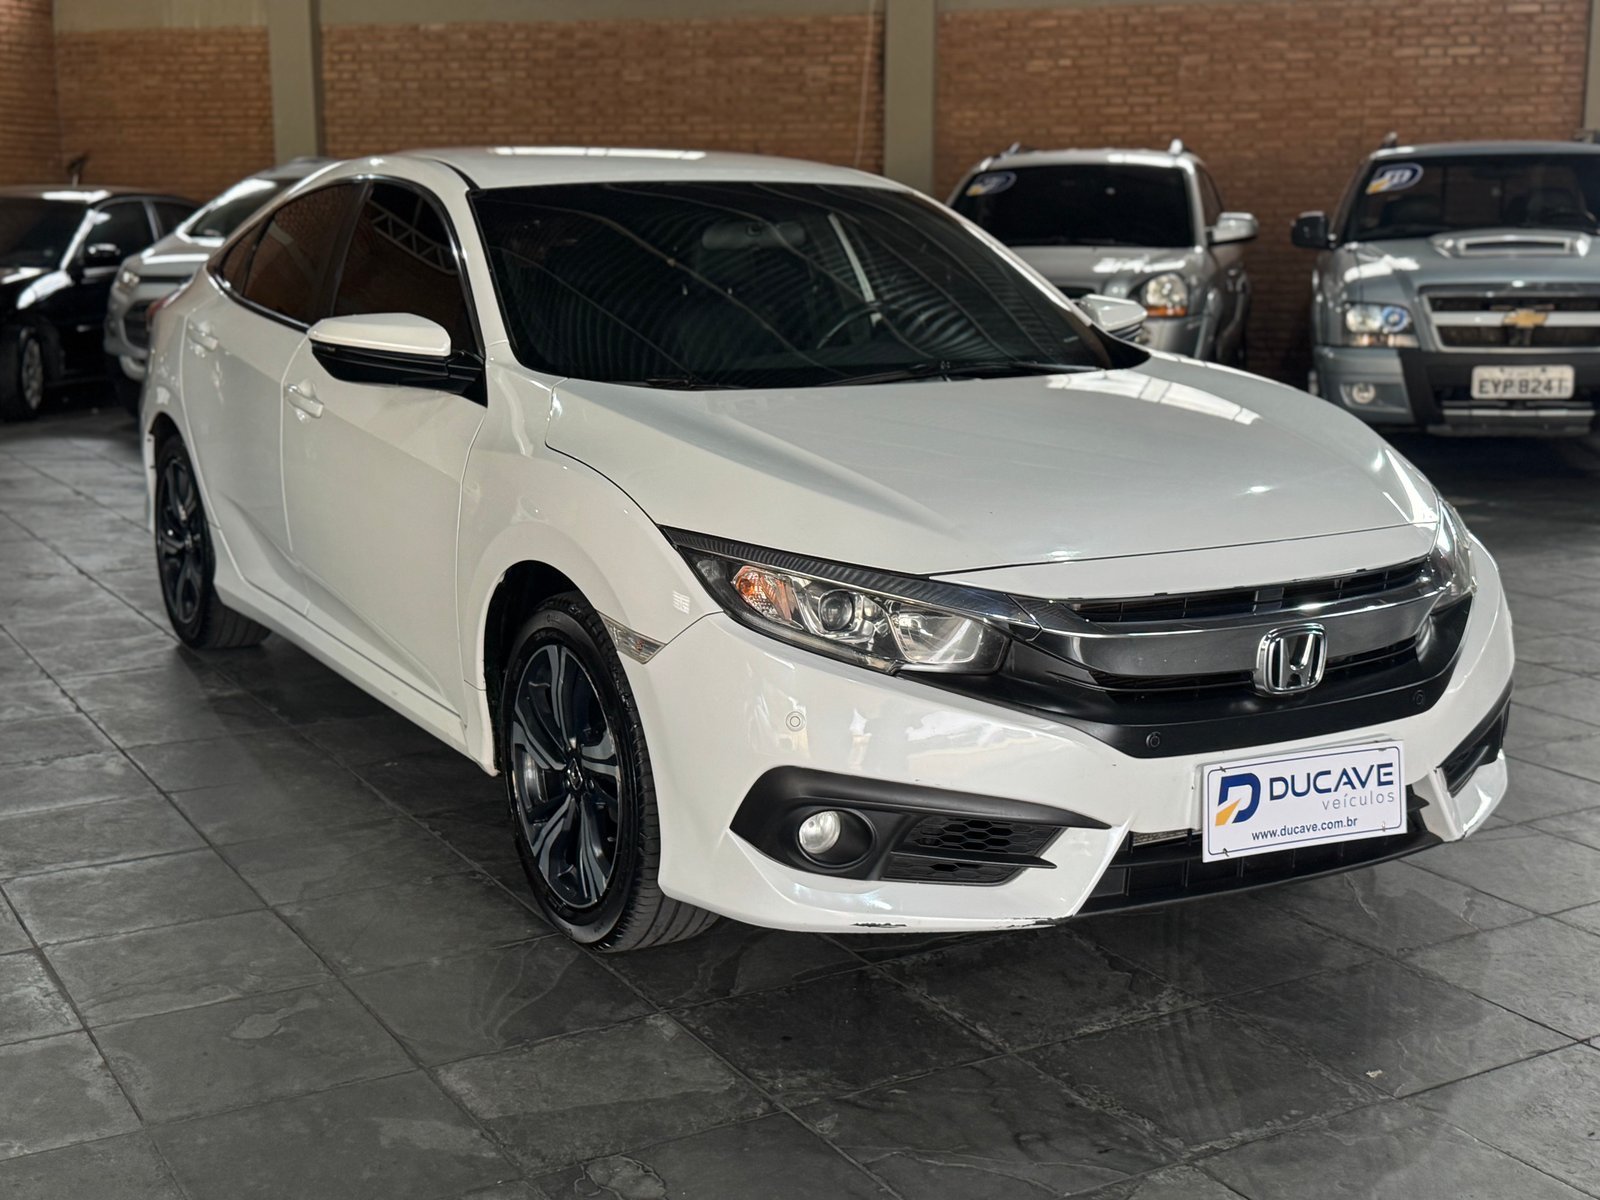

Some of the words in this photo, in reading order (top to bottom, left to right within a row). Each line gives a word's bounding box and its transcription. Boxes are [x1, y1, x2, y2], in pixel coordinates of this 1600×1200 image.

[1269, 762, 1394, 801] DUCAVE
[1322, 790, 1395, 811] veículos
[1251, 816, 1358, 841] www.ducave.com.br
